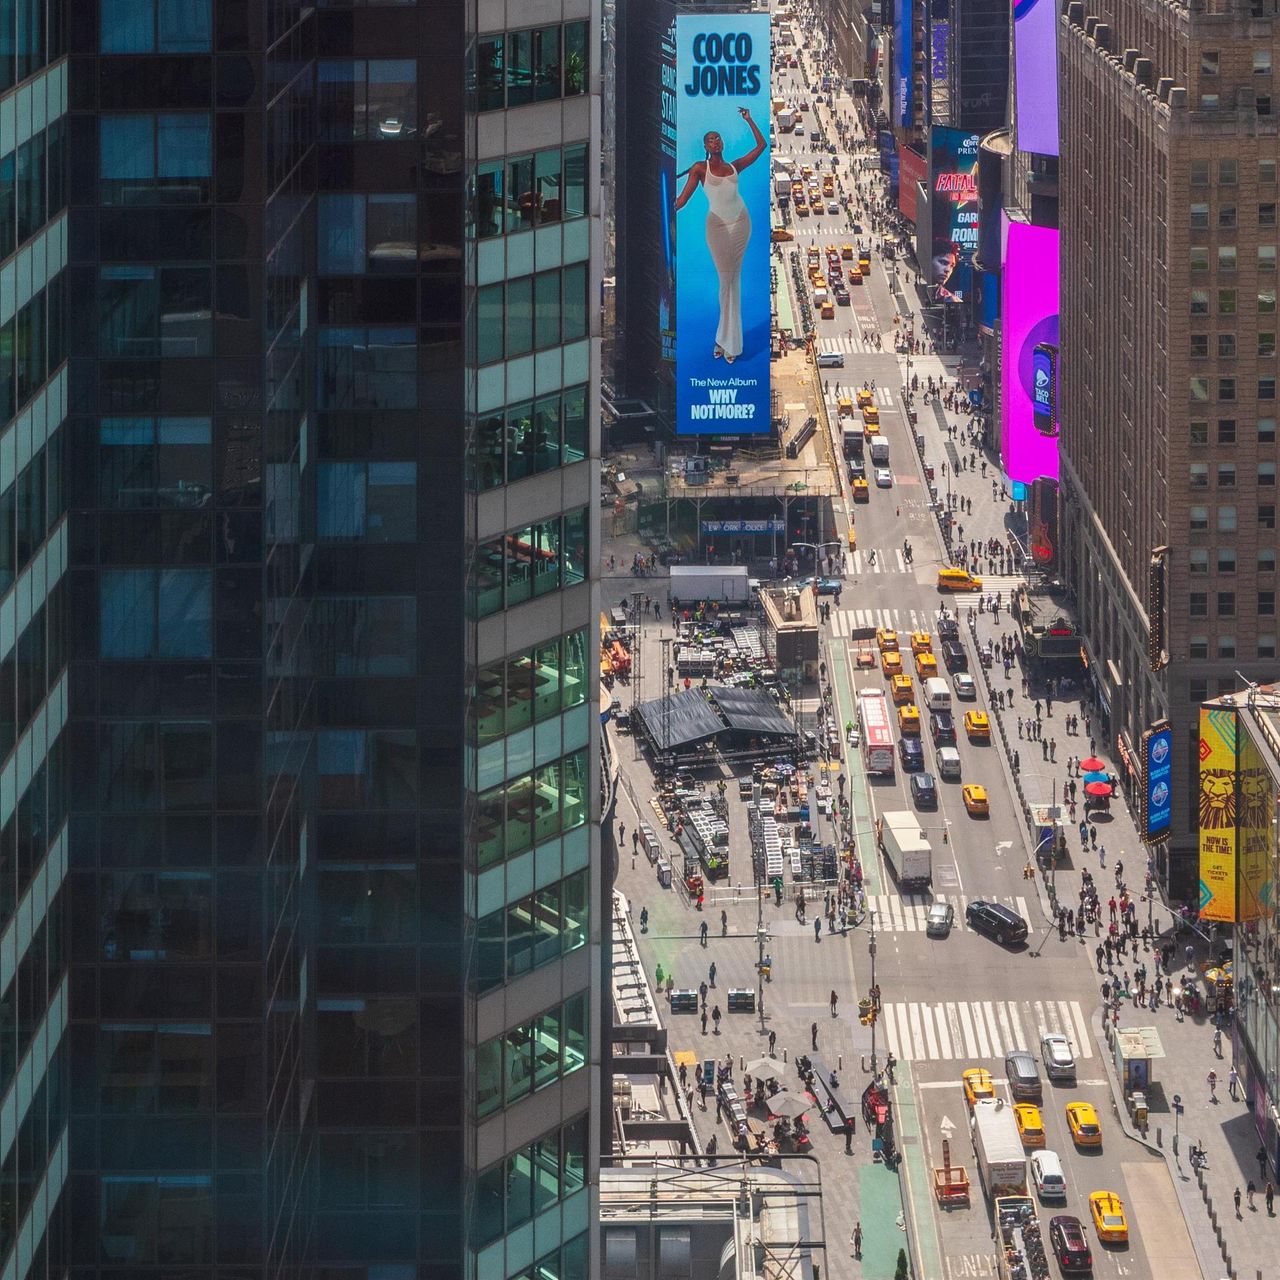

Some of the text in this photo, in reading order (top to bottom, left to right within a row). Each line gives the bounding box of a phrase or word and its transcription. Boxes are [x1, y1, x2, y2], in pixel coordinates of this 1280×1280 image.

[693, 32, 752, 65] COCO
[684, 65, 761, 97] JONES
[936, 173, 978, 191] FATAL
[690, 378, 757, 387] The New Album
[709, 389, 738, 404] WHY
[1035, 387, 1049, 397] TACO
[1036, 394, 1049, 404] BELL
[691, 404, 756, 420] NOT MORE?
[702, 520, 719, 531] NEW
[720, 520, 738, 531] YORK
[740, 520, 766, 531] POLICE
[1207, 836, 1228, 845] NOW IS
[1203, 844, 1232, 854] THE TIME!
